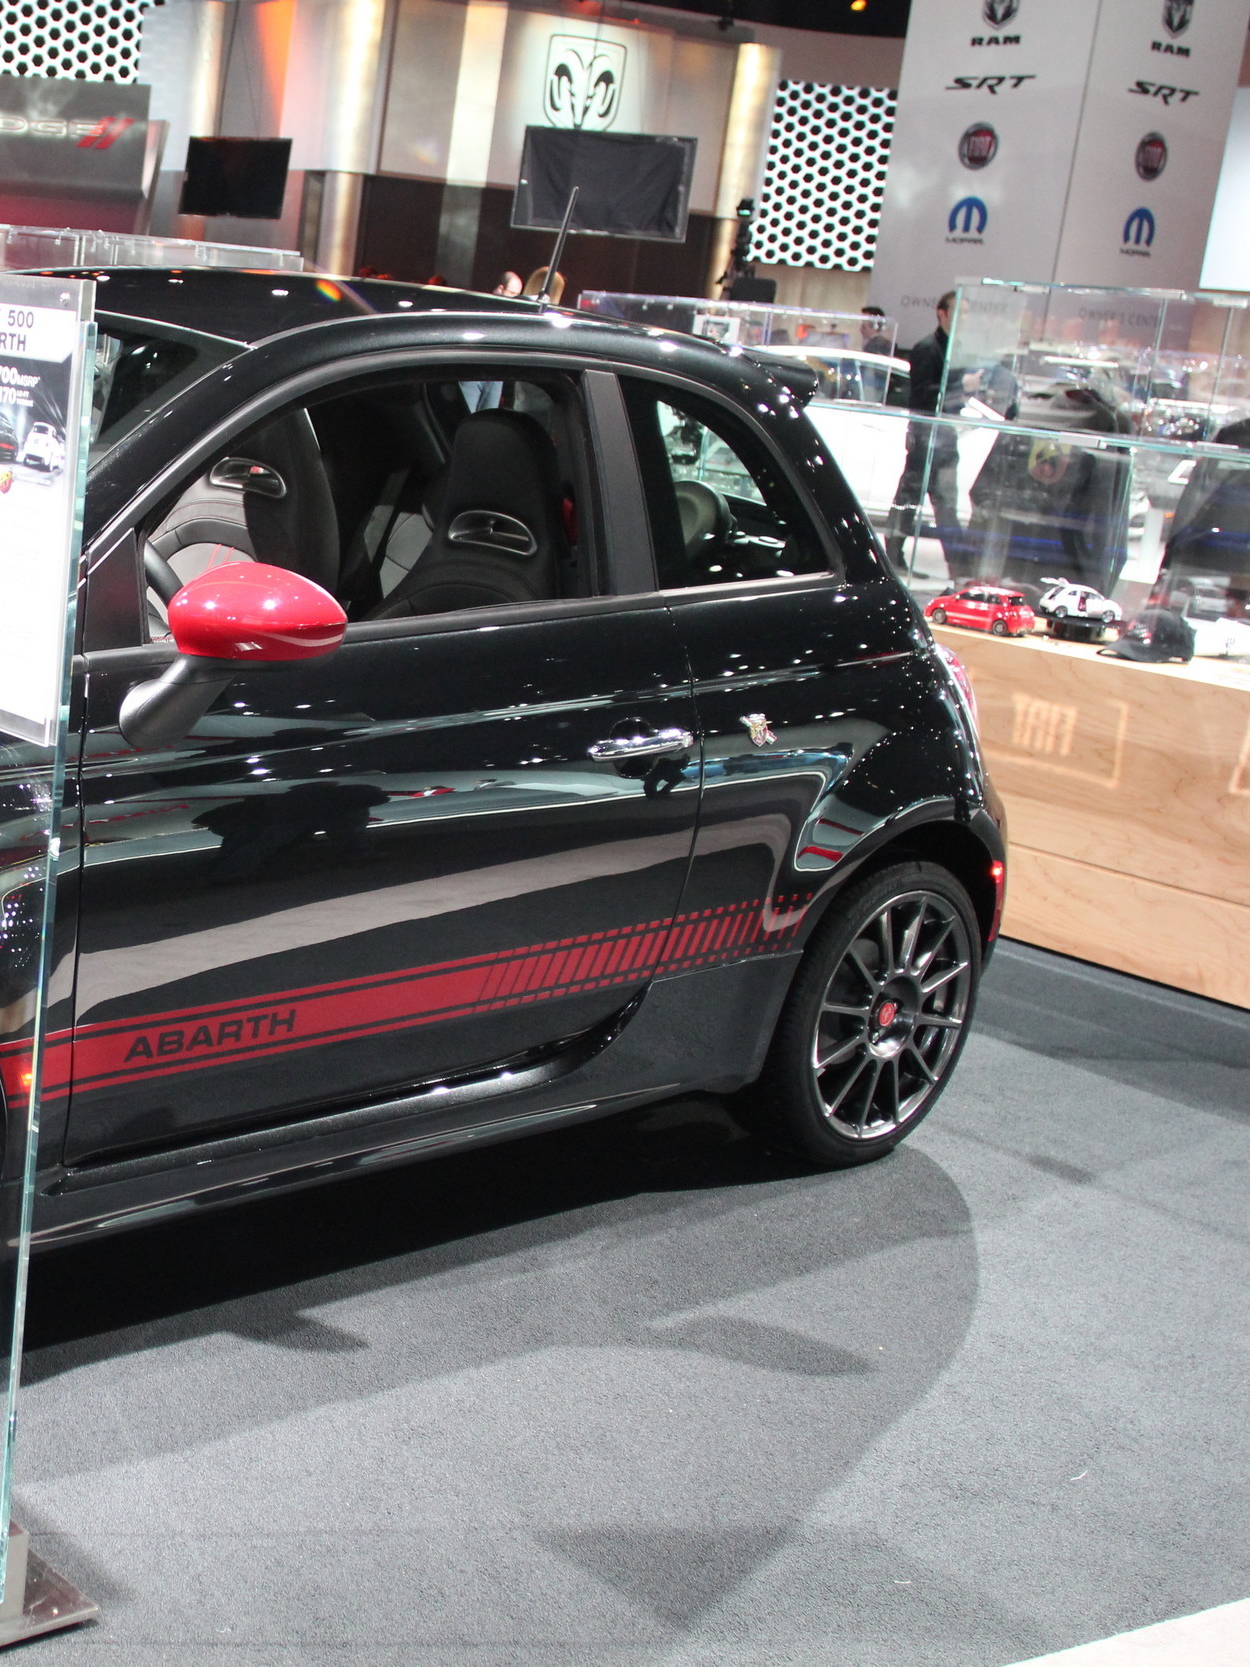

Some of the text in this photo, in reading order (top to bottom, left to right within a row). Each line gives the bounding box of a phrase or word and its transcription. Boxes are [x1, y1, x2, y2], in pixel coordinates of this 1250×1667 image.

[970, 35, 1021, 46] RAM
[1151, 41, 1191, 57] RAM
[945, 74, 1037, 95] SRT
[1127, 80, 1200, 105] SRT
[8, 309, 34, 329] 500
[123, 1009, 296, 1063] ABARTH
